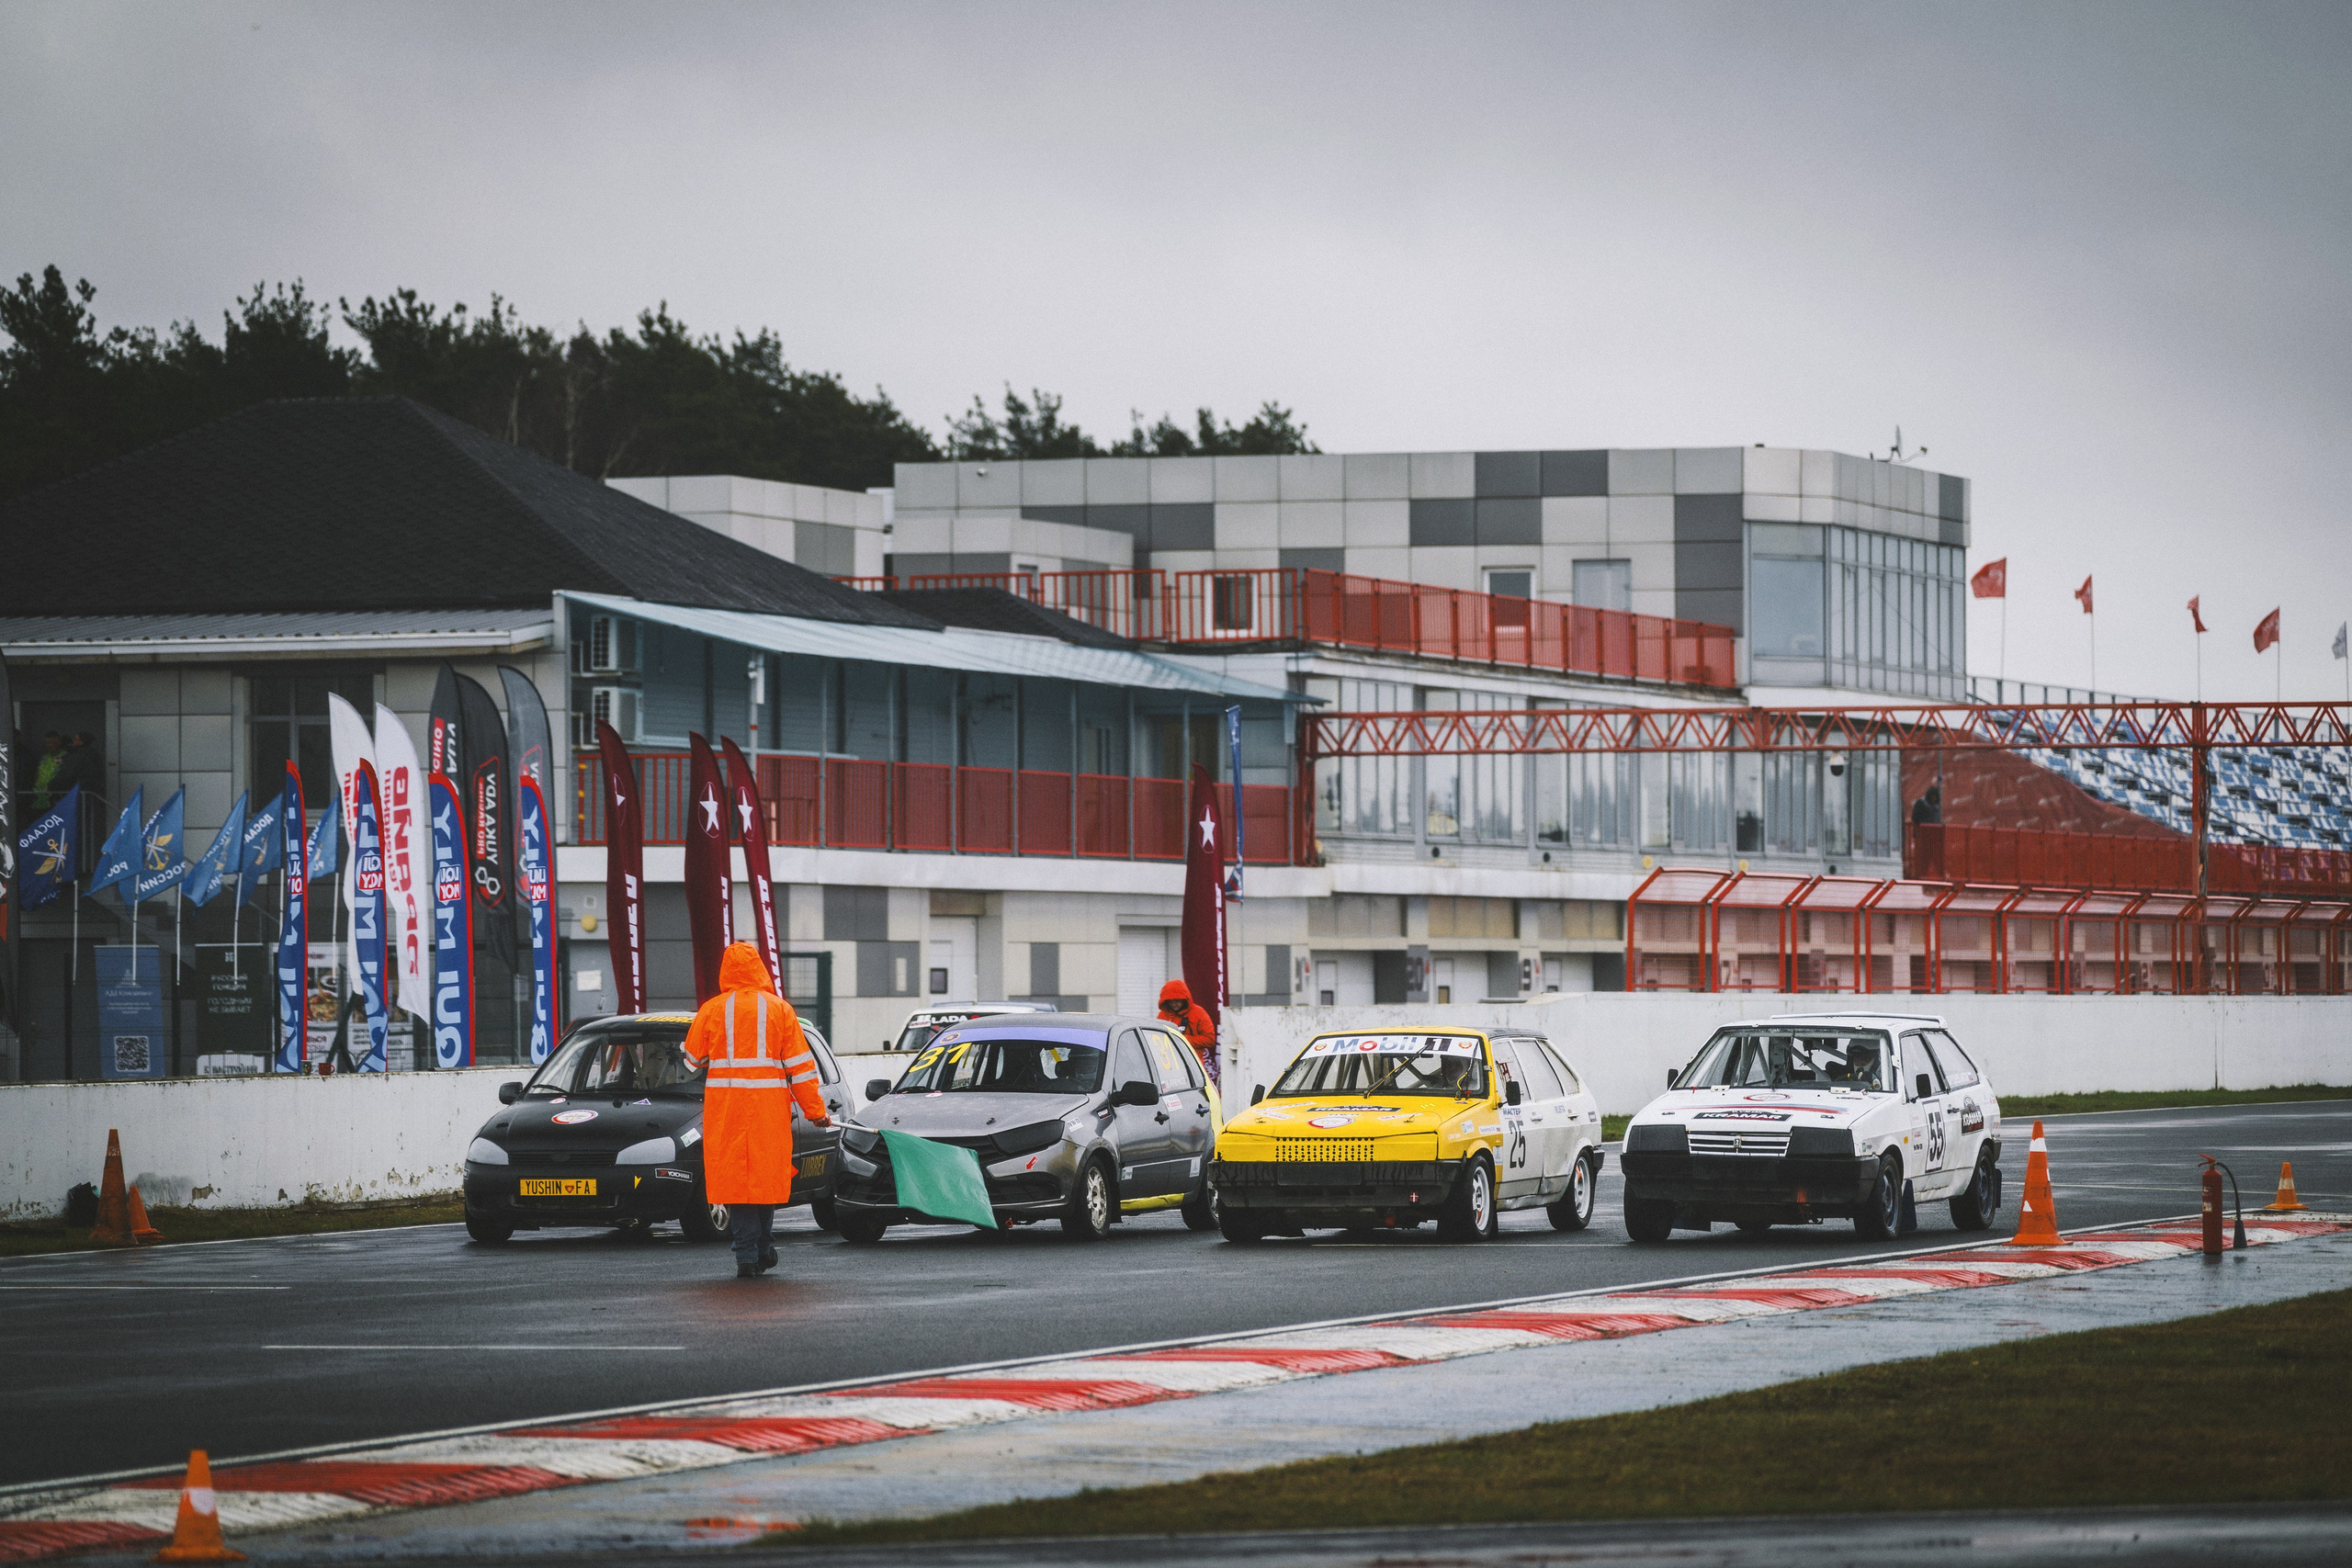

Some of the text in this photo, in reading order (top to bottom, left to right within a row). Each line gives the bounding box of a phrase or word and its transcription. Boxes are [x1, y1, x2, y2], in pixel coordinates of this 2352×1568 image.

[931, 1015, 968, 1024] LADA
[1152, 1033, 1180, 1071] 31
[1332, 1037, 1418, 1053] Mobil
[909, 1043, 972, 1073] 31
[1508, 1120, 1526, 1169] 25
[1928, 1111, 1944, 1162] 55
[667, 1171, 690, 1179] YOKOHAMA
[525, 1180, 562, 1194] YUSHIN
